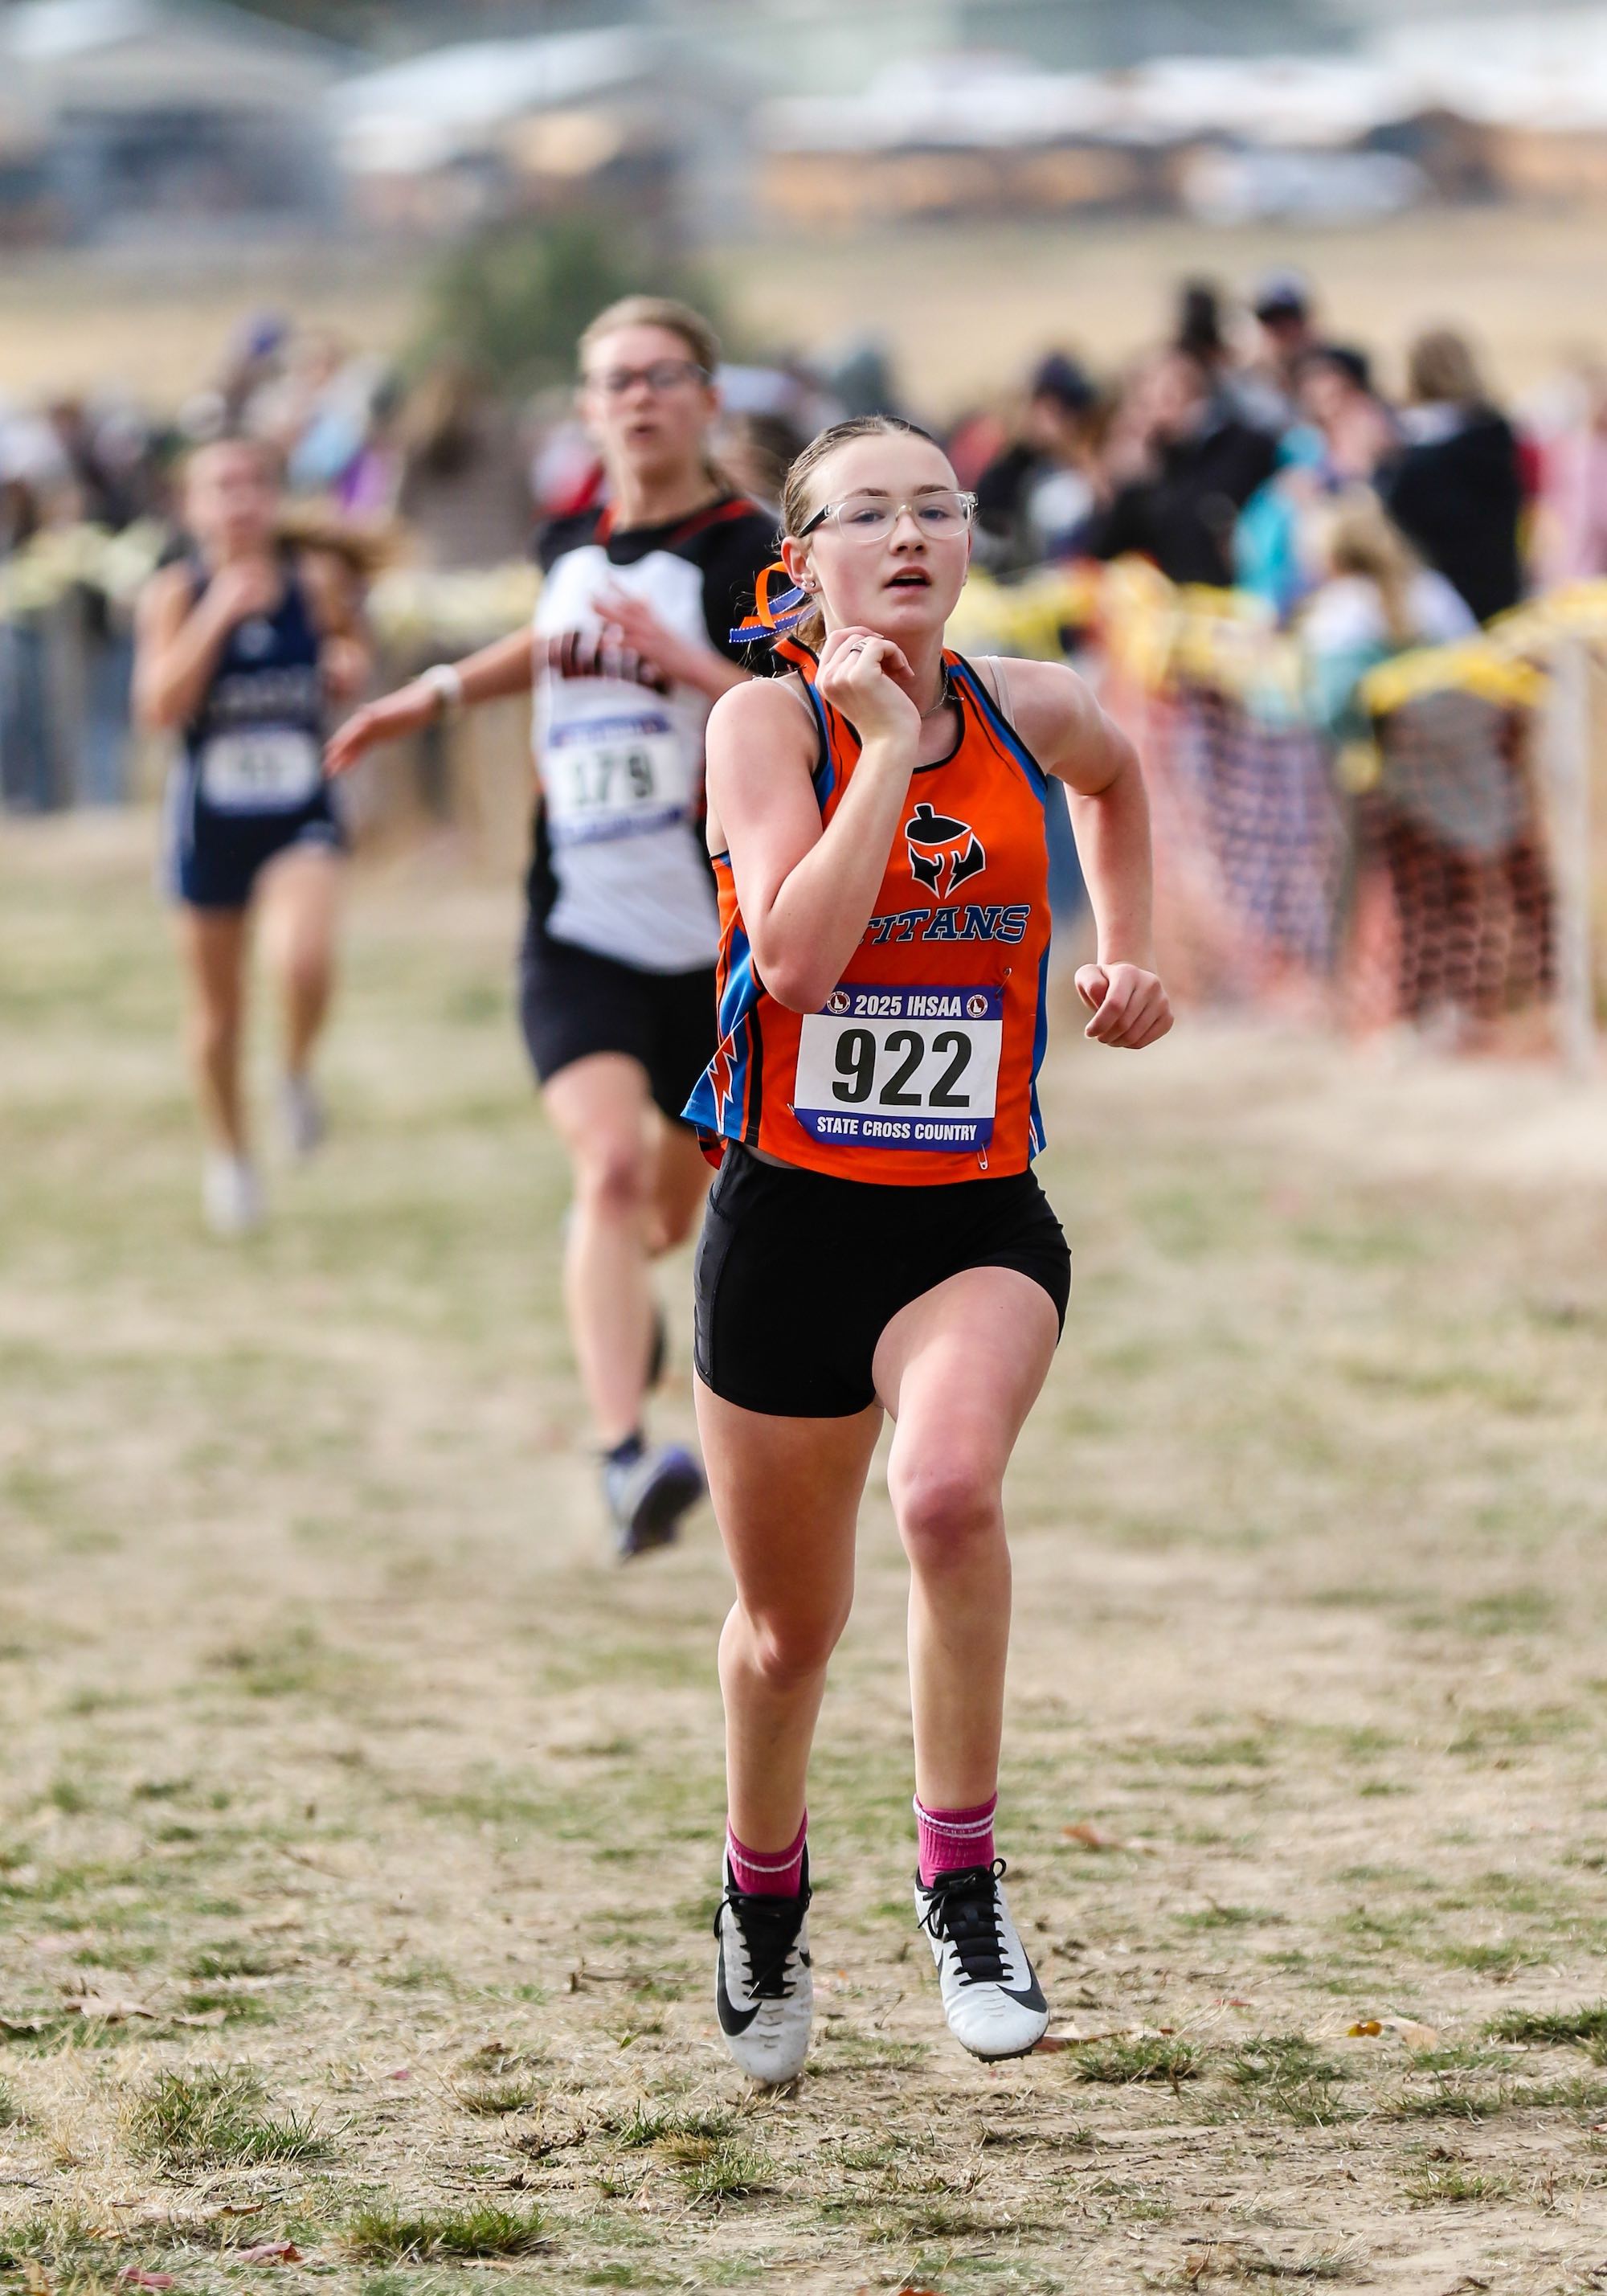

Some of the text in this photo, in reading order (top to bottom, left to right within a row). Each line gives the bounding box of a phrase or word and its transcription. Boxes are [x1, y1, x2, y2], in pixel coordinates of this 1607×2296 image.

[854, 994, 902, 1016] 2025
[906, 996, 963, 1017] IHSAA
[832, 1029, 972, 1107] 922
[816, 1115, 977, 1141] STATE CROSS COUNTRY
